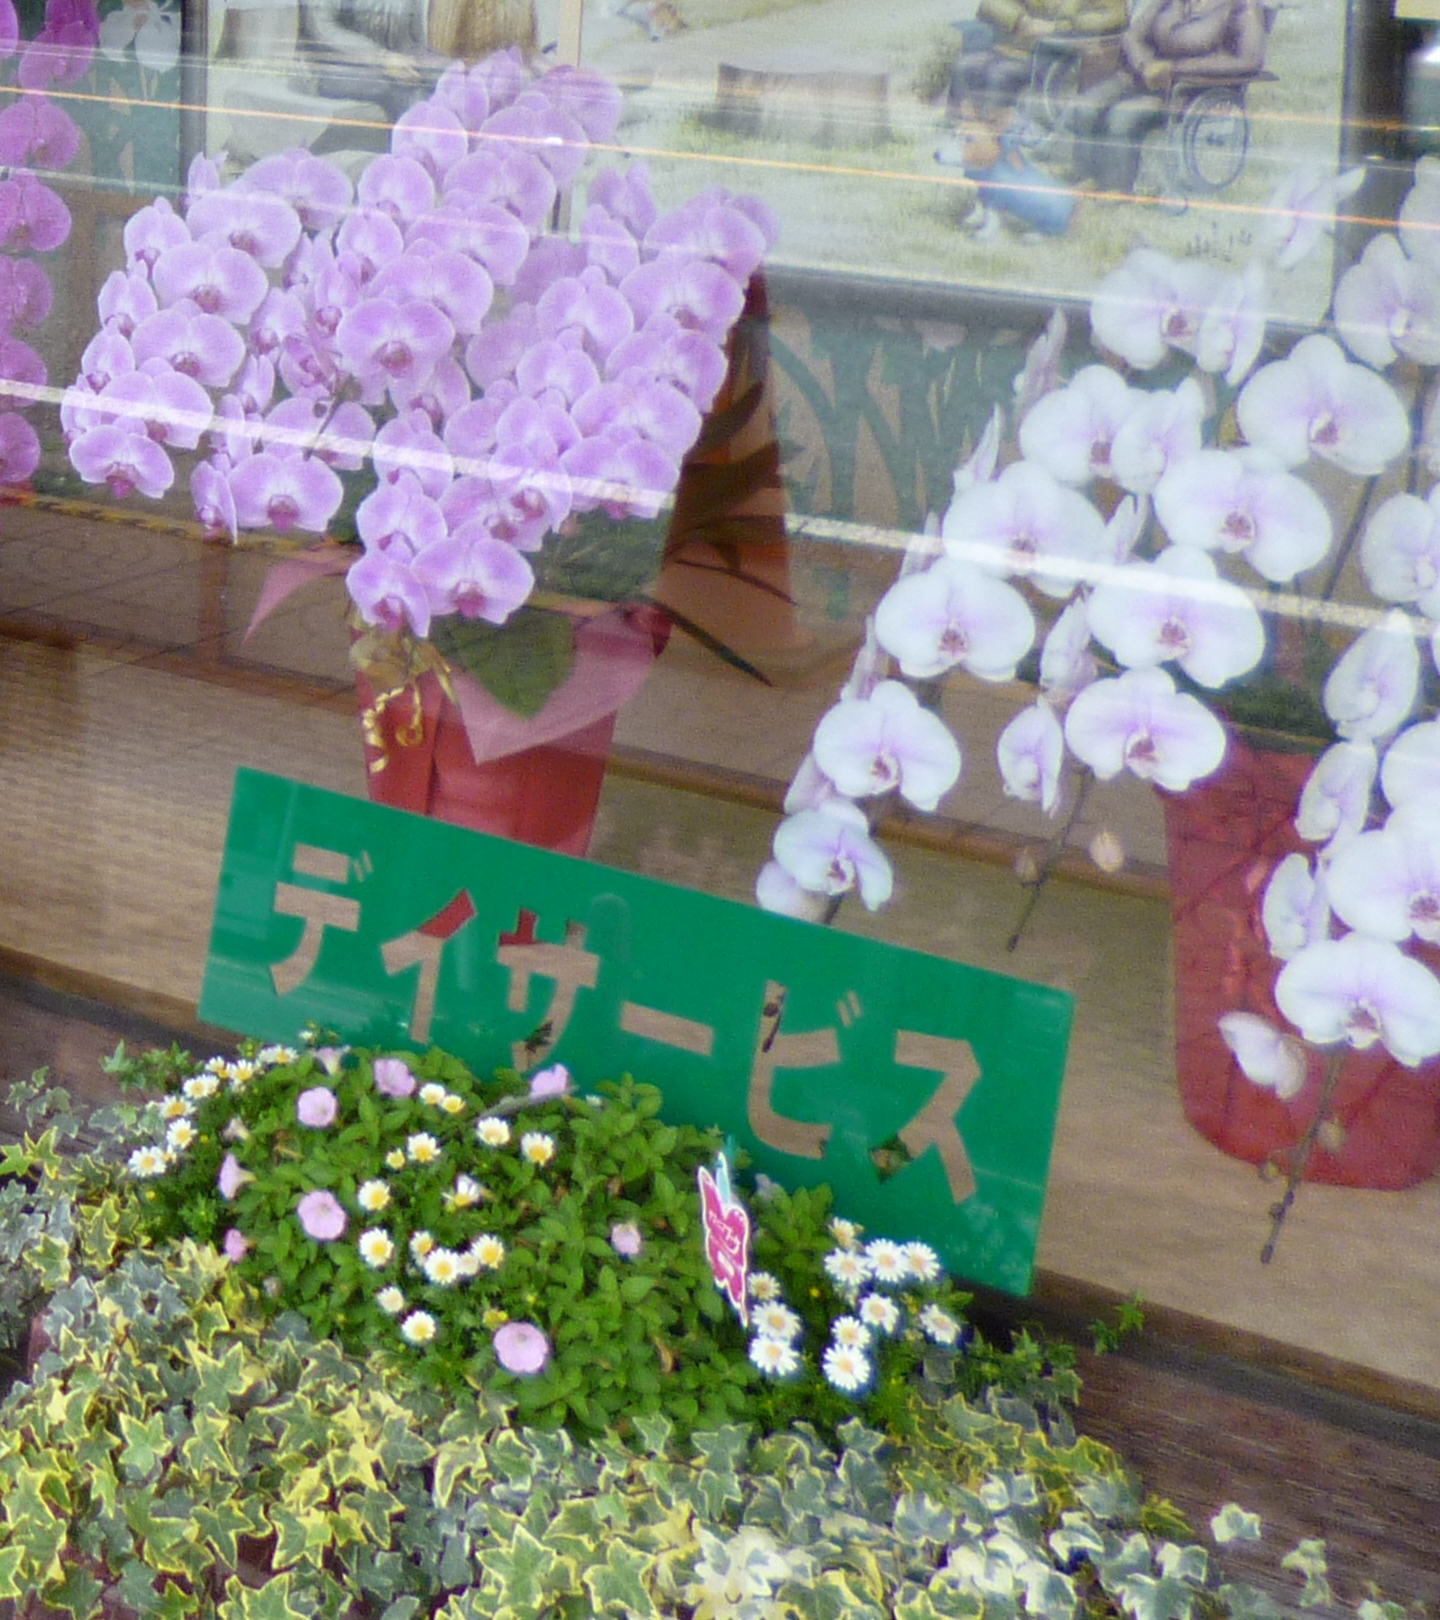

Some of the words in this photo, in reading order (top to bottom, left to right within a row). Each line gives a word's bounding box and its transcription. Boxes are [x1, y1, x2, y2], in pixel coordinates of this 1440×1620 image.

[268, 842, 983, 1205] デイサービス
